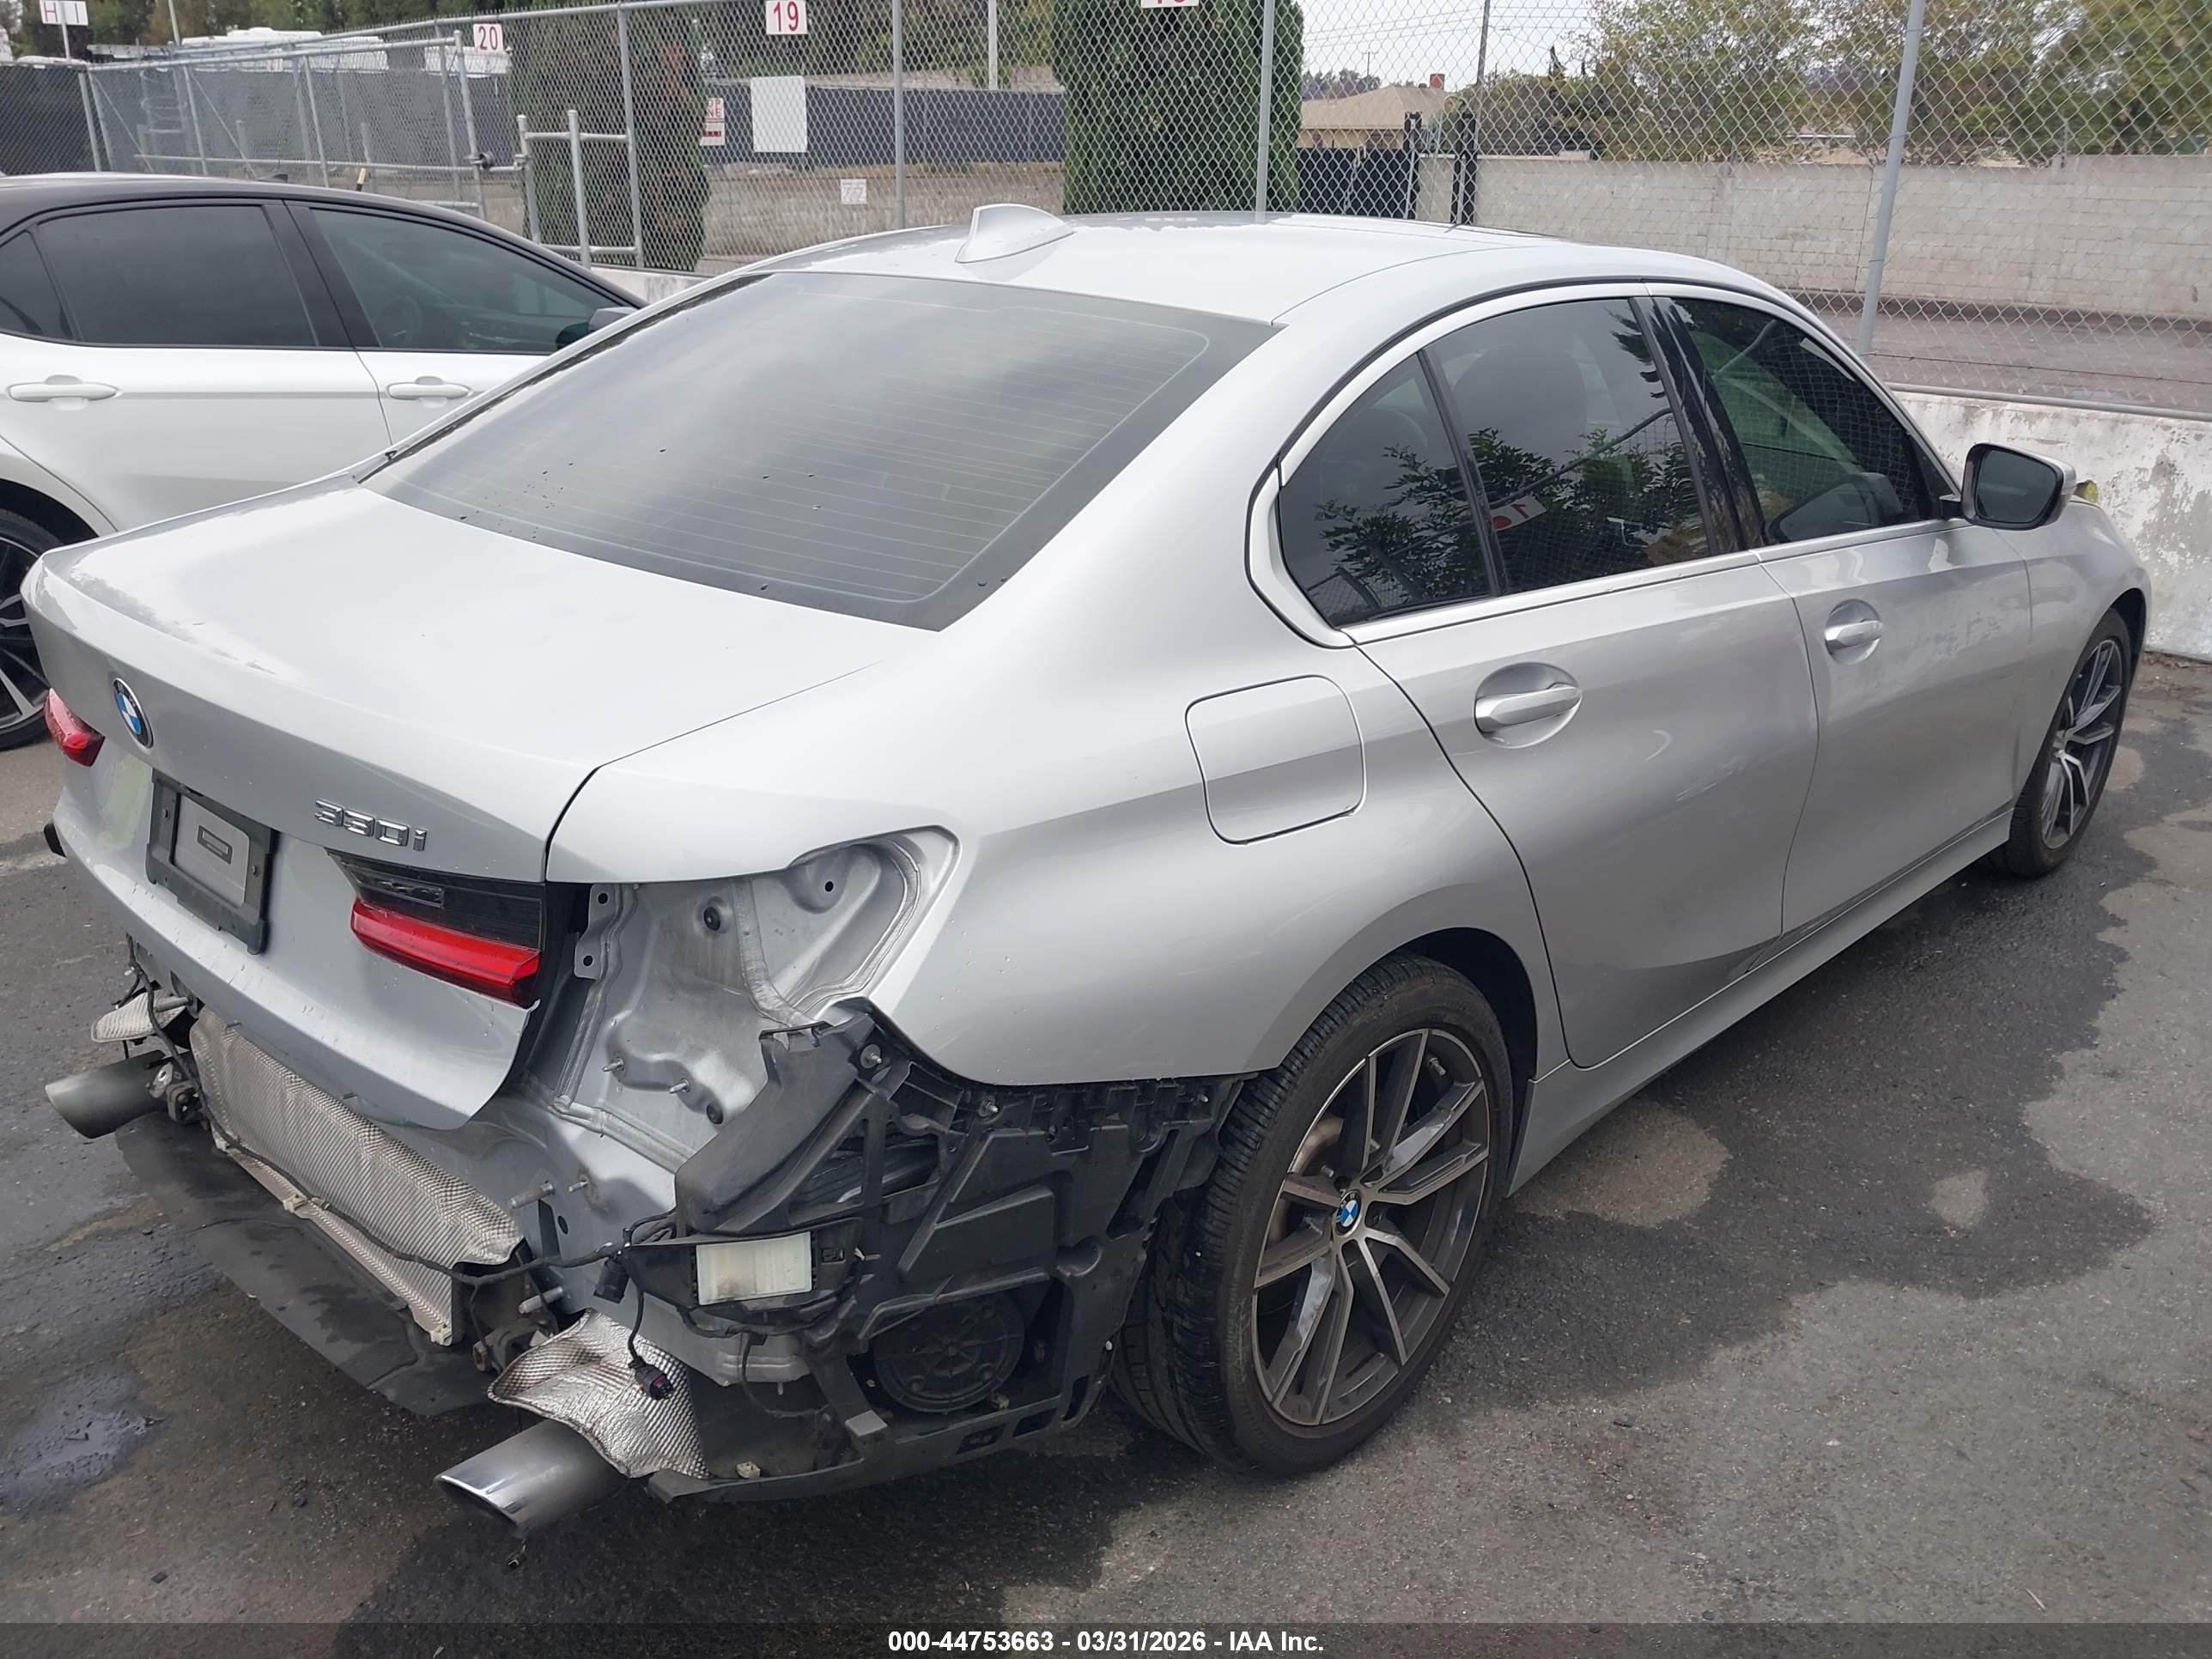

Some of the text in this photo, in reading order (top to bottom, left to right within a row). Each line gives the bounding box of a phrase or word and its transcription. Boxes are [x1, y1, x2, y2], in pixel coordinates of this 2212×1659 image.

[774, 2, 799, 32] 19
[478, 26, 498, 50] 20
[314, 798, 428, 851] 330i
